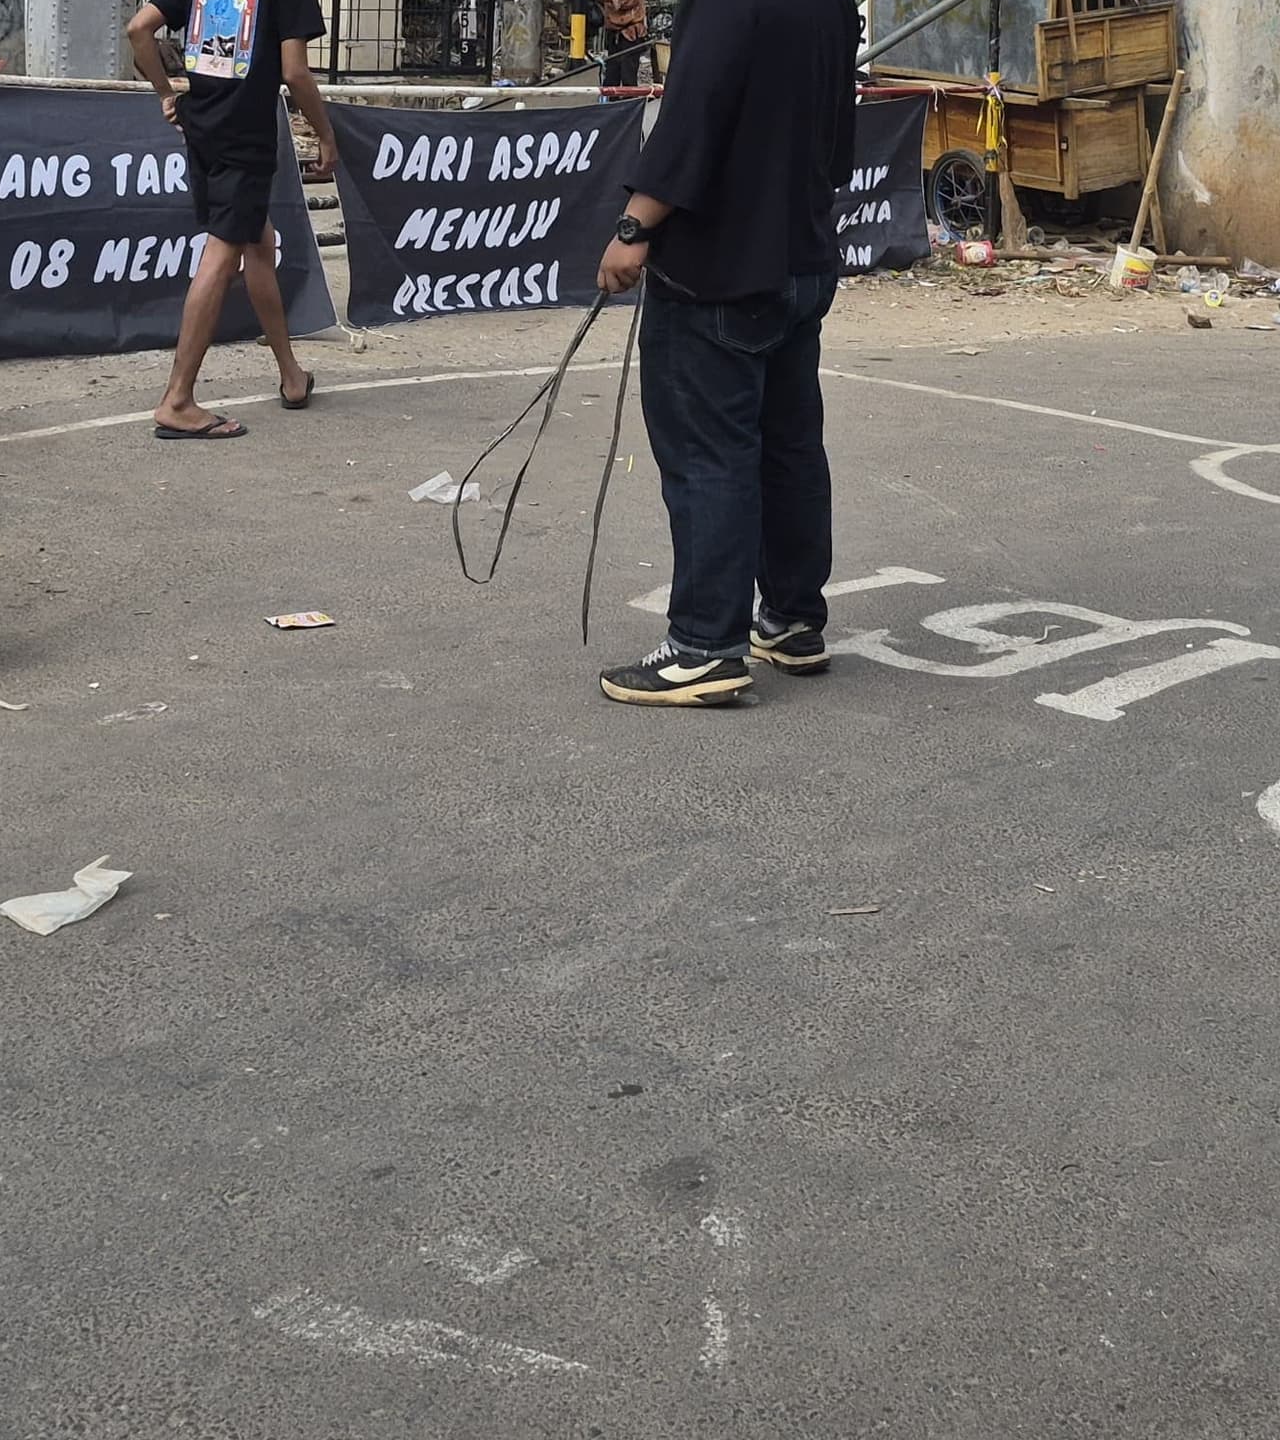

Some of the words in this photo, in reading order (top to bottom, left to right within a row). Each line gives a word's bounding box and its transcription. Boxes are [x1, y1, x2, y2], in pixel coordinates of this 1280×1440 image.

[111, 153, 189, 197] TAR
[372, 133, 473, 182] DARI
[488, 129, 600, 182] ASPAL
[394, 197, 561, 252] MENUJU
[10, 238, 75, 290] 08
[93, 230, 282, 283] MENT
[840, 244, 872, 266] AN
[392, 260, 559, 315] PRESTASI
